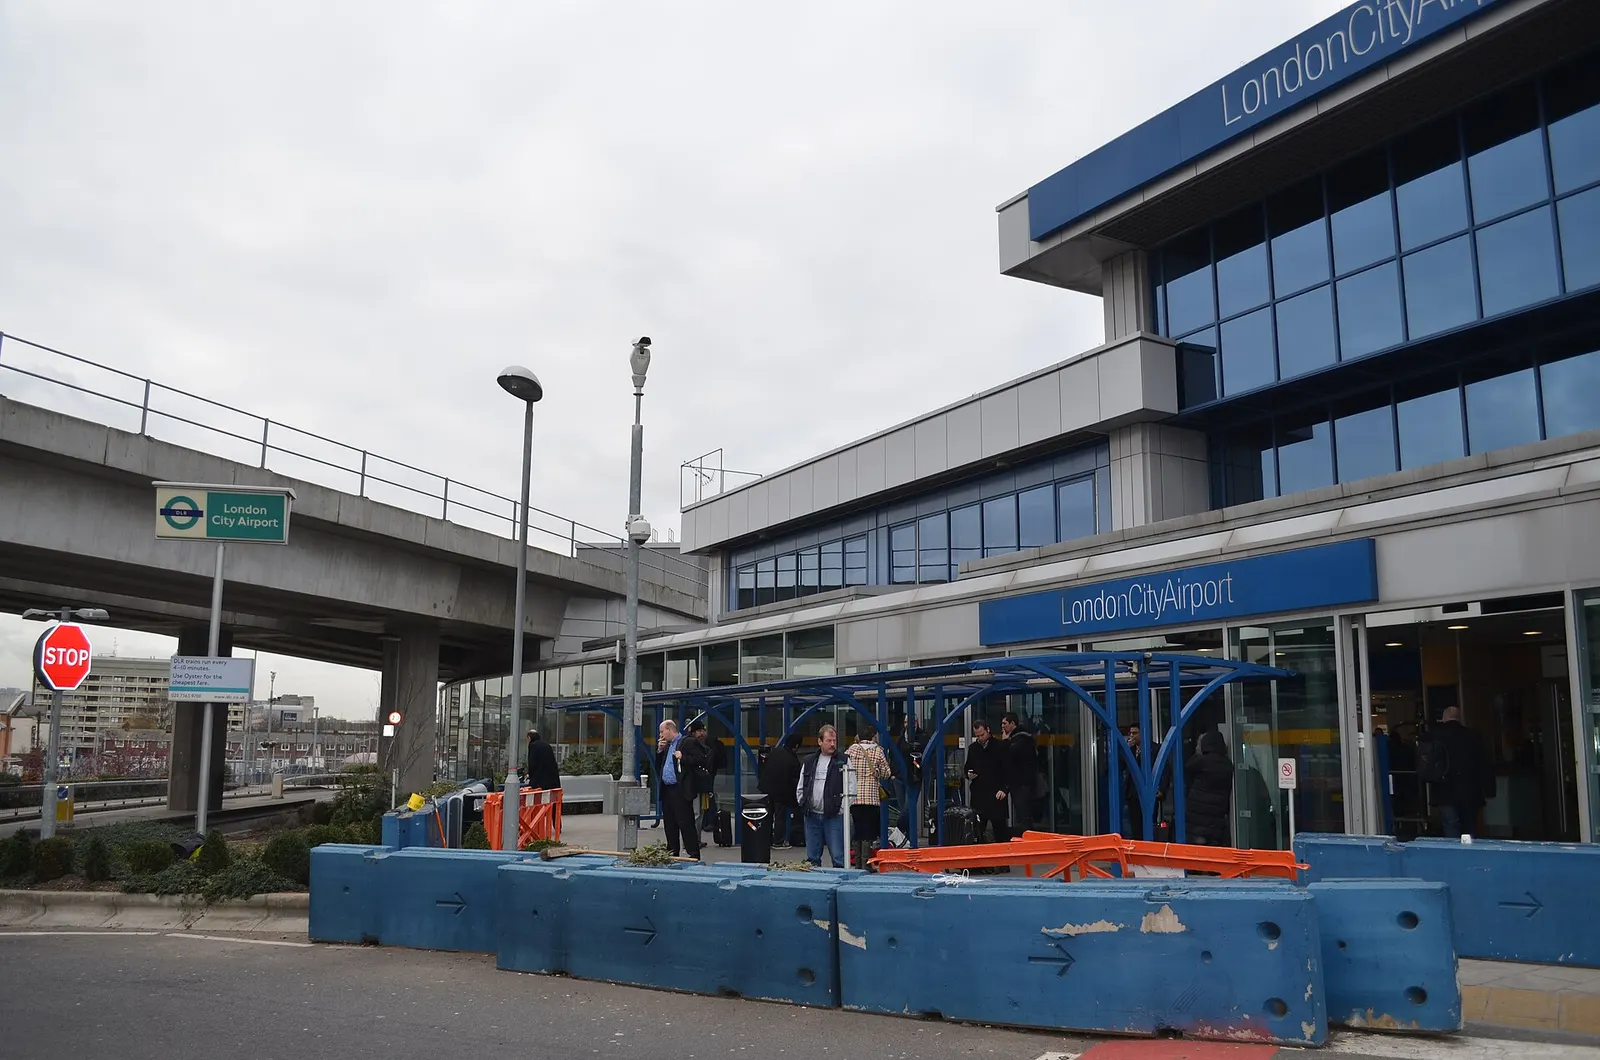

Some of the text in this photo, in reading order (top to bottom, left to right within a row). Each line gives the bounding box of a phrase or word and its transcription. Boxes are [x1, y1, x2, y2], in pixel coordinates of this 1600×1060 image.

[1221, 0, 1481, 127] LondonCity
[224, 503, 267, 515] London
[212, 515, 279, 529] City Airport
[1061, 571, 1234, 625] LondonCityAirport
[45, 646, 89, 667] STOP
